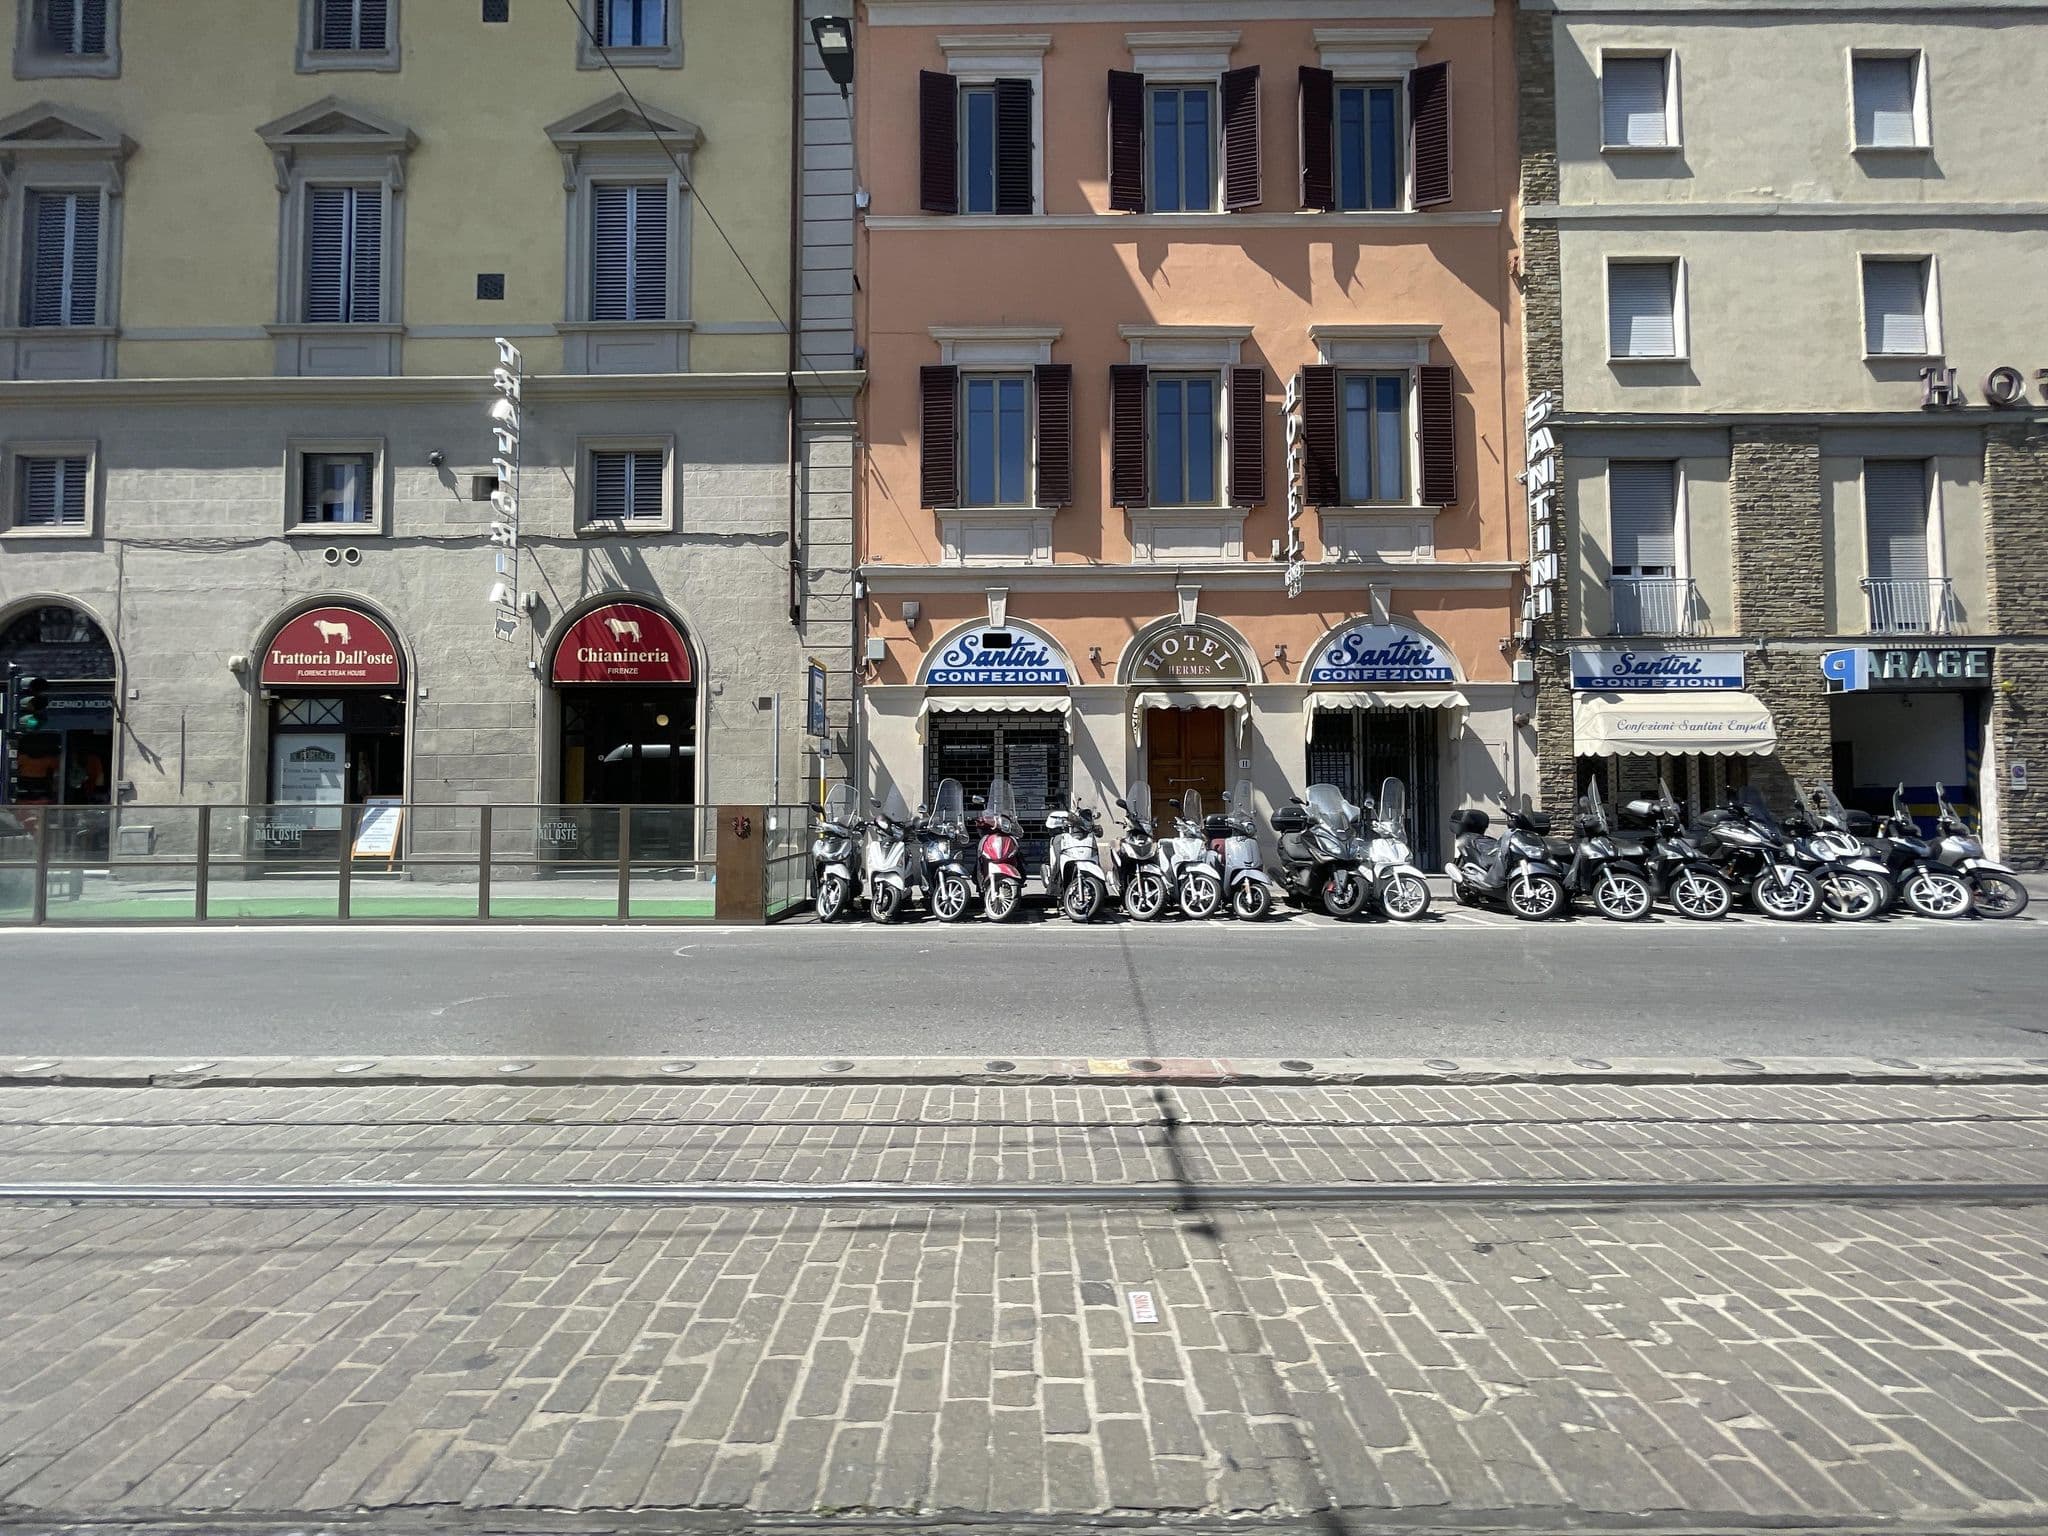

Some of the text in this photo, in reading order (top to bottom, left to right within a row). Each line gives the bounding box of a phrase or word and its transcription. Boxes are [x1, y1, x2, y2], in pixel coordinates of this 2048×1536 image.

[1282, 374, 1304, 558] HOTEL
[1527, 389, 1558, 619] SANTINI
[271, 650, 394, 665] Trattoria Dall'oste
[577, 648, 670, 663] Chianineria
[943, 634, 1050, 668] Santini
[1142, 634, 1232, 671] HOTEL
[1327, 633, 1435, 667] Santini
[607, 667, 639, 675] FIRENZE
[1168, 665, 1211, 675] HERMES
[1612, 652, 1702, 676] Santini
[297, 669, 367, 677] FLORENCE STEAK HOUSE
[934, 671, 1061, 682] CONFEZIONI
[1318, 669, 1446, 681] CONFEZIONI
[1591, 678, 1724, 687] CONFEZIONI
[1617, 719, 1768, 733] Confezioni Santini Empoli
